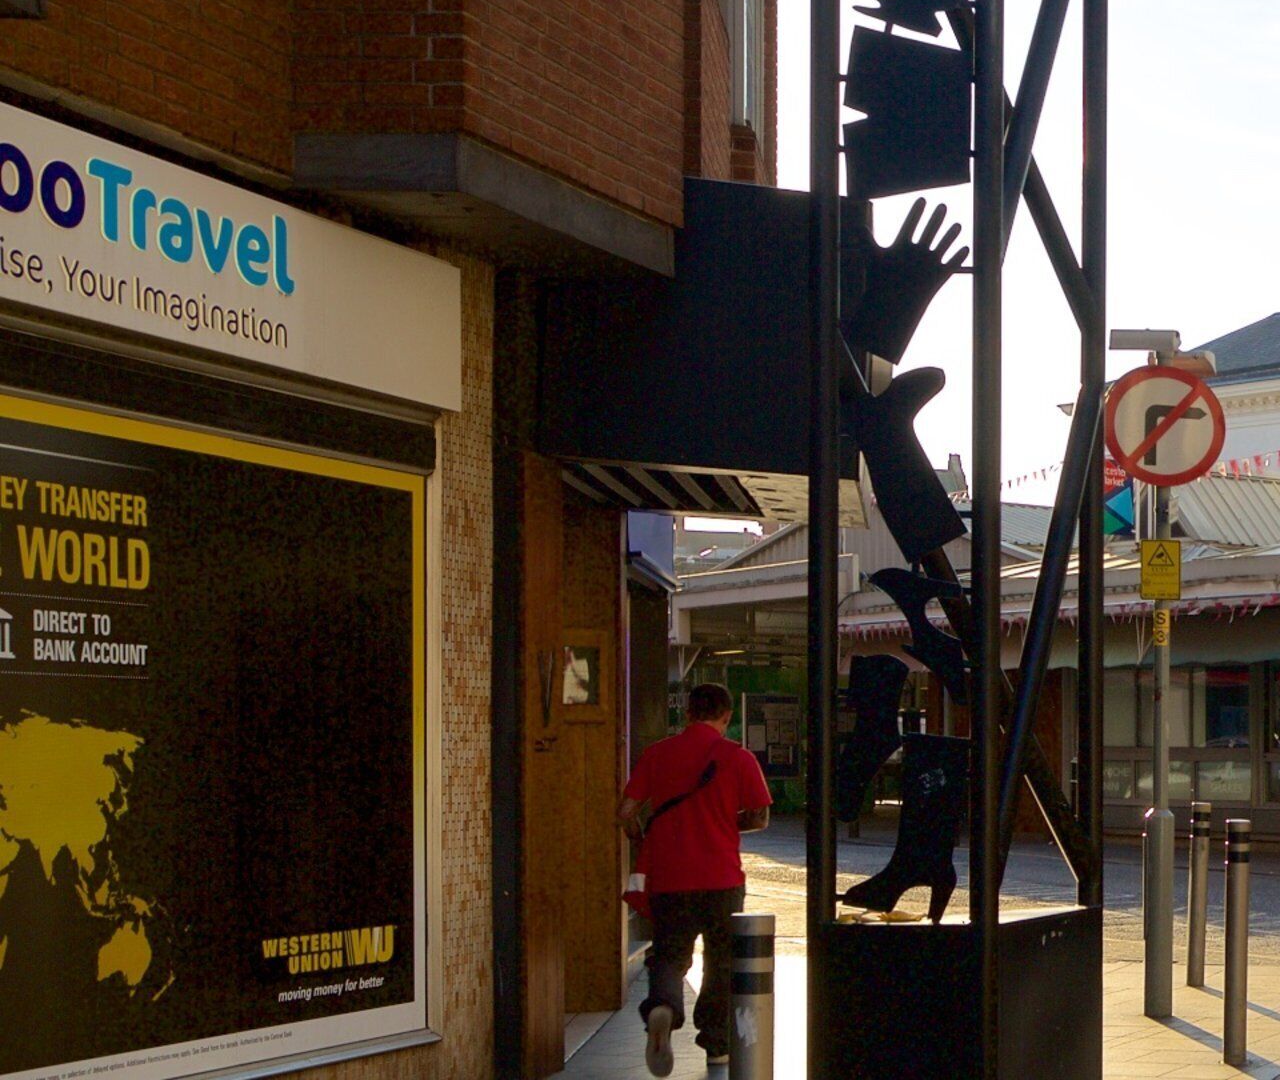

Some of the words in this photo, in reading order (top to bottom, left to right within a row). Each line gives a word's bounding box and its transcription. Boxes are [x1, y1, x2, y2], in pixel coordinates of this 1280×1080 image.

[59, 255, 127, 306] Your
[133, 276, 289, 350] Imagination
[36, 480, 148, 528] TRANSFER
[16, 524, 150, 591] WORLD
[33, 608, 87, 634] DIRECT
[91, 613, 111, 637] TO
[33, 638, 76, 663] BANK
[80, 641, 148, 666] ACCOUNT
[262, 931, 343, 959] WESTERN
[350, 924, 396, 967] WU
[288, 949, 343, 975] UNION
[278, 986, 312, 1003] moving
[313, 983, 344, 997] money
[345, 978, 358, 992] for
[359, 975, 385, 990] better
